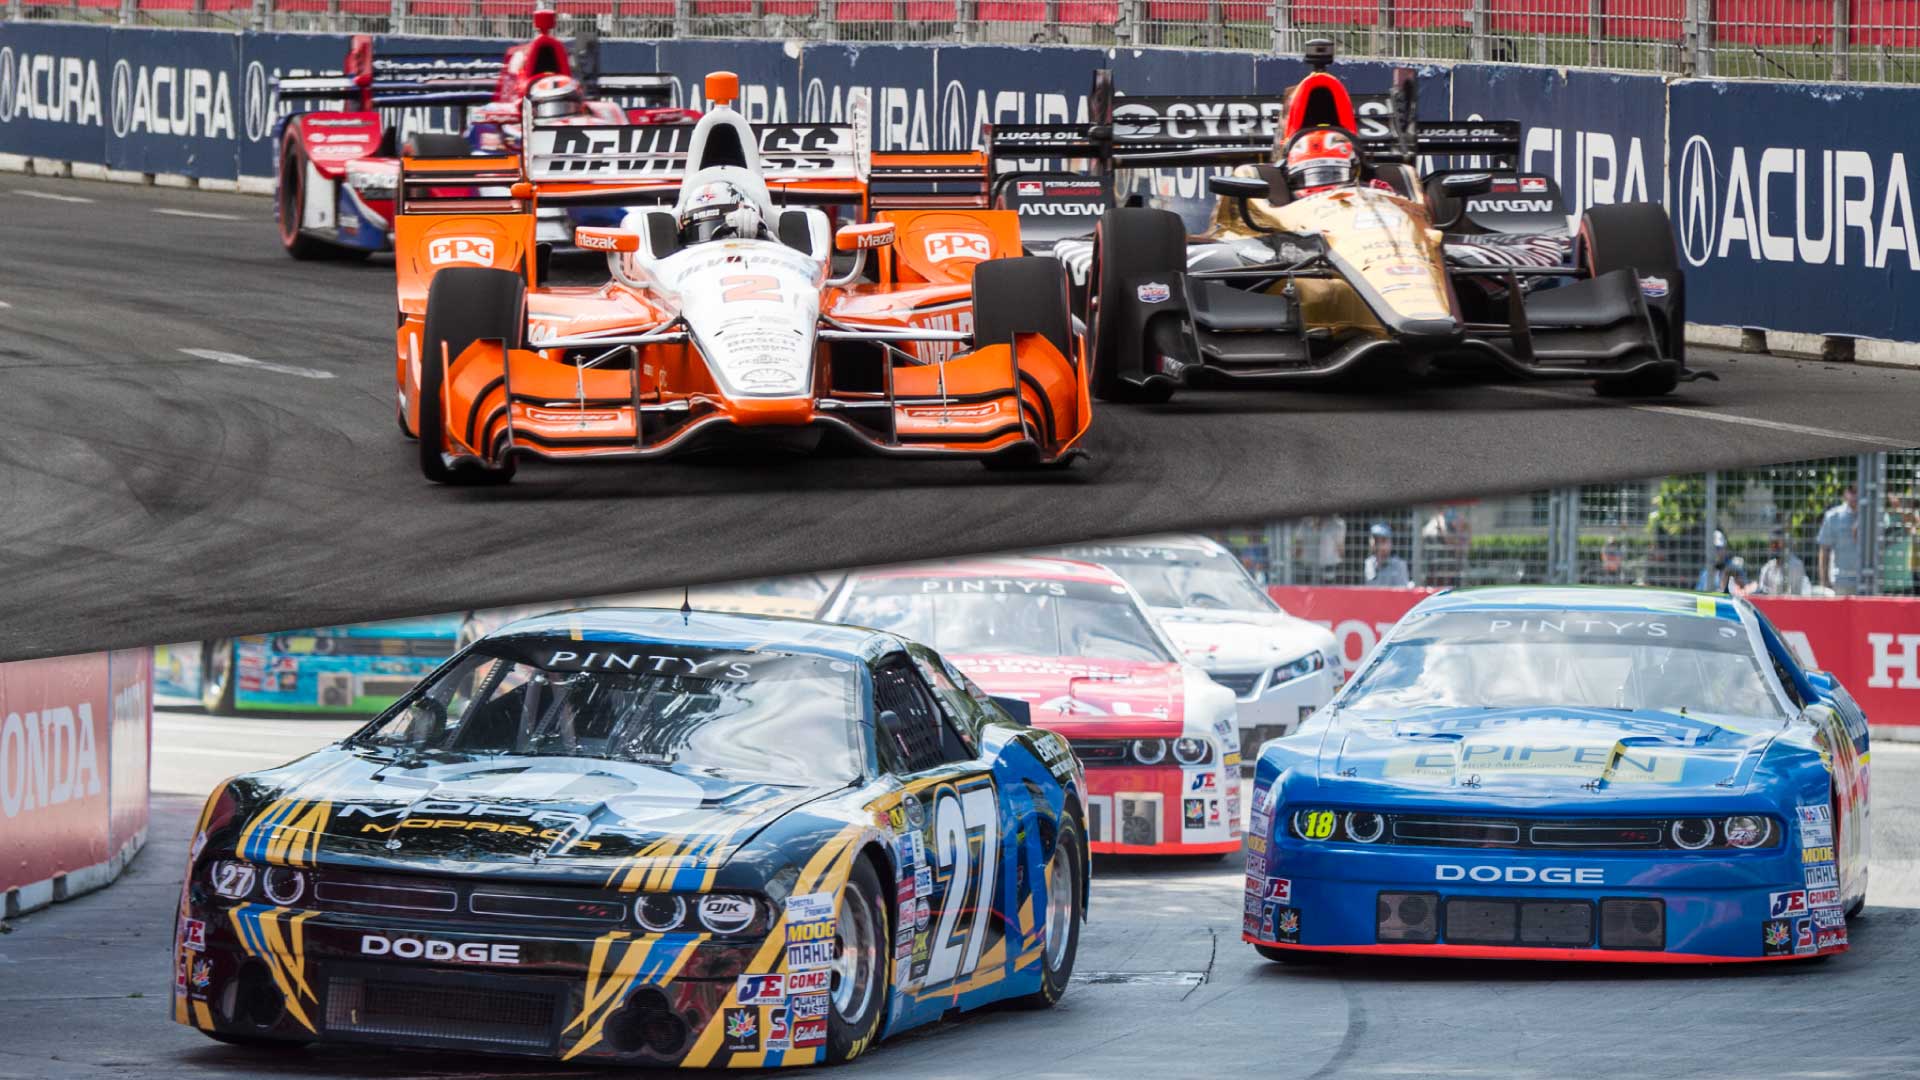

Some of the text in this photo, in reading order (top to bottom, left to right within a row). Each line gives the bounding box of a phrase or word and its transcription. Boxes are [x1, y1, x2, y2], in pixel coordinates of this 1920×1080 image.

[14, 53, 103, 127] ACURA
[131, 65, 235, 140] ACURA
[996, 131, 1083, 140] LUCAS OIL
[1470, 128, 1499, 136] OIL
[1018, 203, 1105, 215] ARROW
[1466, 200, 1553, 212] ARROW
[1718, 147, 1920, 271] ACURA
[432, 239, 490, 259] PPG
[577, 231, 618, 250] Mazak
[928, 235, 987, 256] PPG
[720, 275, 784, 303] 2
[922, 580, 1066, 596] PINTY'S
[1489, 619, 1668, 637] PINTY'S
[547, 651, 751, 679] PINTY'S
[1415, 744, 1657, 773] EPIPEN
[1191, 772, 1216, 790] JE
[337, 801, 650, 837] MOPAR
[1305, 812, 1334, 837] 18
[217, 864, 254, 897] 27
[1435, 864, 1605, 884] DODGE
[924, 786, 996, 987] 27
[1773, 892, 1804, 916] JE
[788, 922, 835, 942] MOOG
[361, 935, 521, 964] DODGE
[788, 943, 834, 966] MAHLE
[737, 976, 783, 1002] JE
[788, 972, 823, 989] COMP
